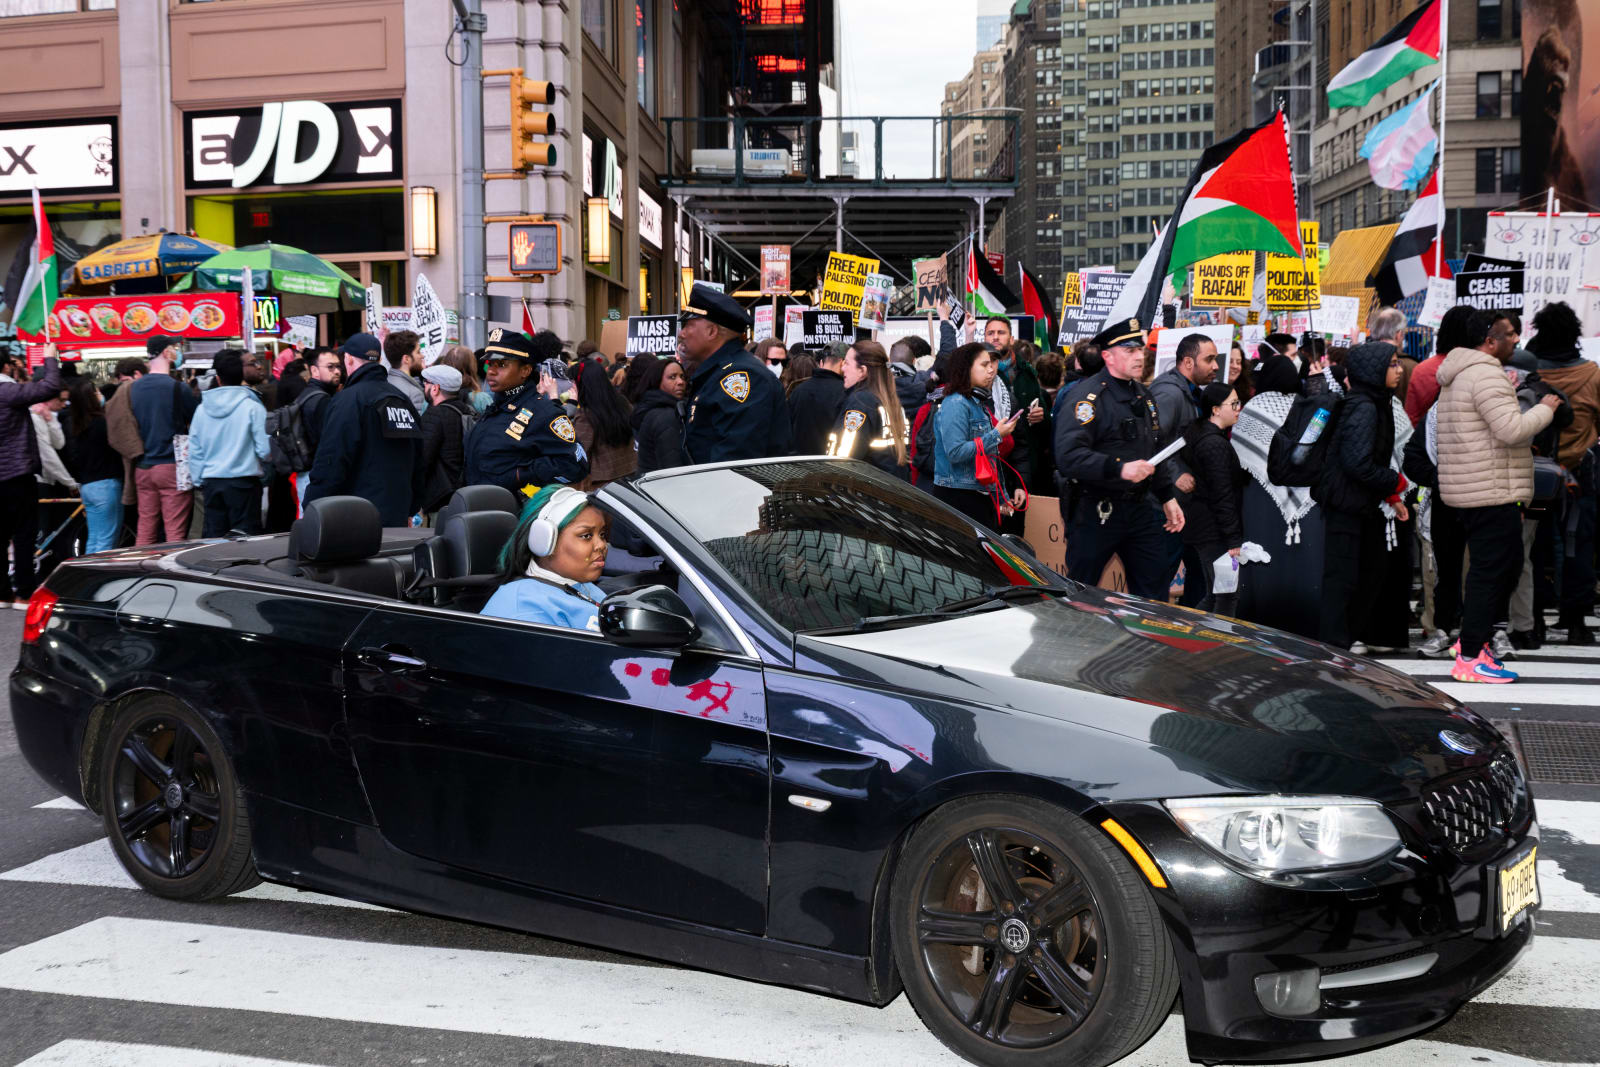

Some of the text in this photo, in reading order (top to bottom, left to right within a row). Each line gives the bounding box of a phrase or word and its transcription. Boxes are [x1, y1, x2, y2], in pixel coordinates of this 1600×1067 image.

[232, 101, 339, 188] JD
[1304, 229, 1316, 244] LL
[82, 260, 153, 280] SABRETT
[829, 257, 856, 274] FREE
[1199, 265, 1250, 278] HANDS OFF
[867, 276, 892, 289] STOP
[1201, 279, 1246, 296] RAFAH!
[1469, 278, 1510, 294] CEASE
[1457, 294, 1524, 310] APARTHEID
[818, 314, 840, 324] ISRAEL
[1077, 321, 1099, 332] THIRST
[638, 320, 670, 336] MASS
[816, 325, 843, 334] IS BUILT
[628, 336, 676, 353] MURDER
[805, 335, 814, 344] ON
[1060, 332, 1073, 342] FOR
[386, 407, 415, 423] NYPD
